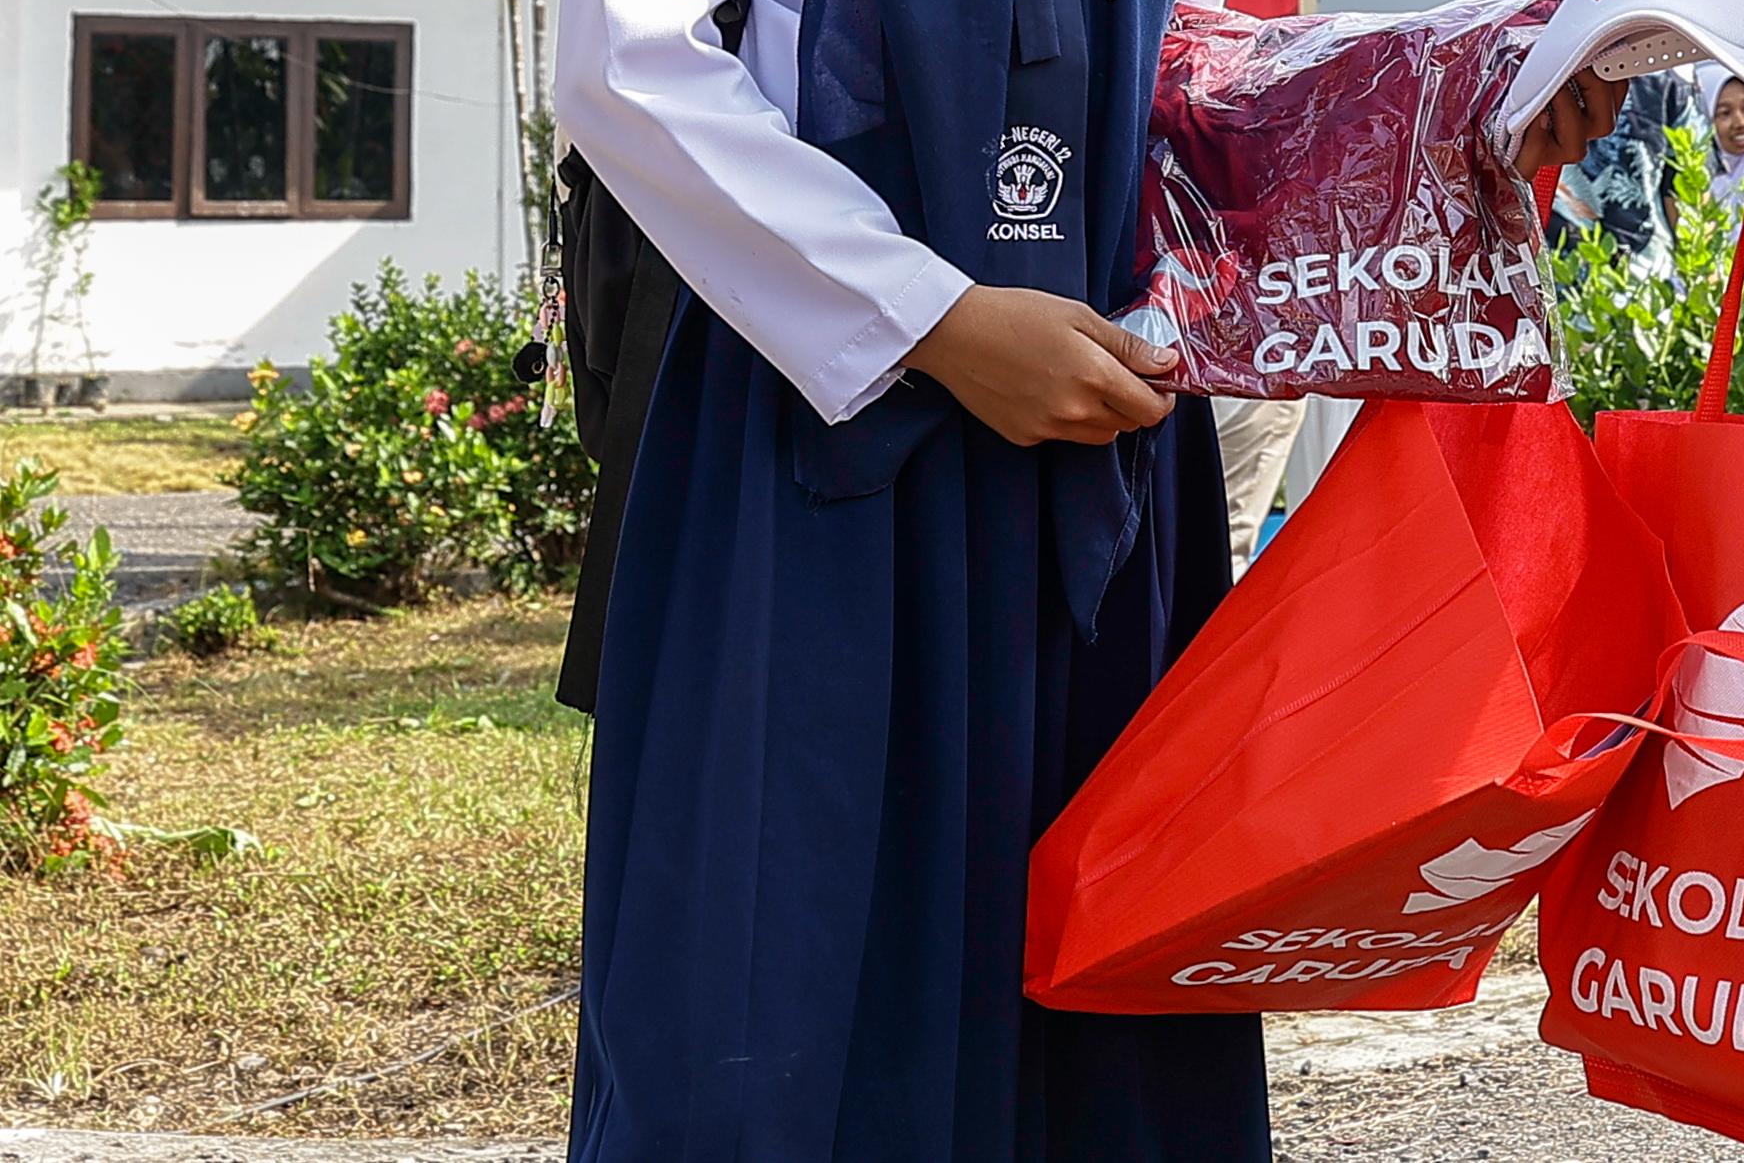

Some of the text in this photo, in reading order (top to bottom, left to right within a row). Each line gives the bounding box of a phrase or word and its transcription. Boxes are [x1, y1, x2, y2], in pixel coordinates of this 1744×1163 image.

[1011, 126, 1062, 152] NEGERI
[986, 222, 1065, 240] KONSEL
[1255, 242, 1542, 305] SEKOLAH
[1251, 317, 1551, 376] GARUDA
